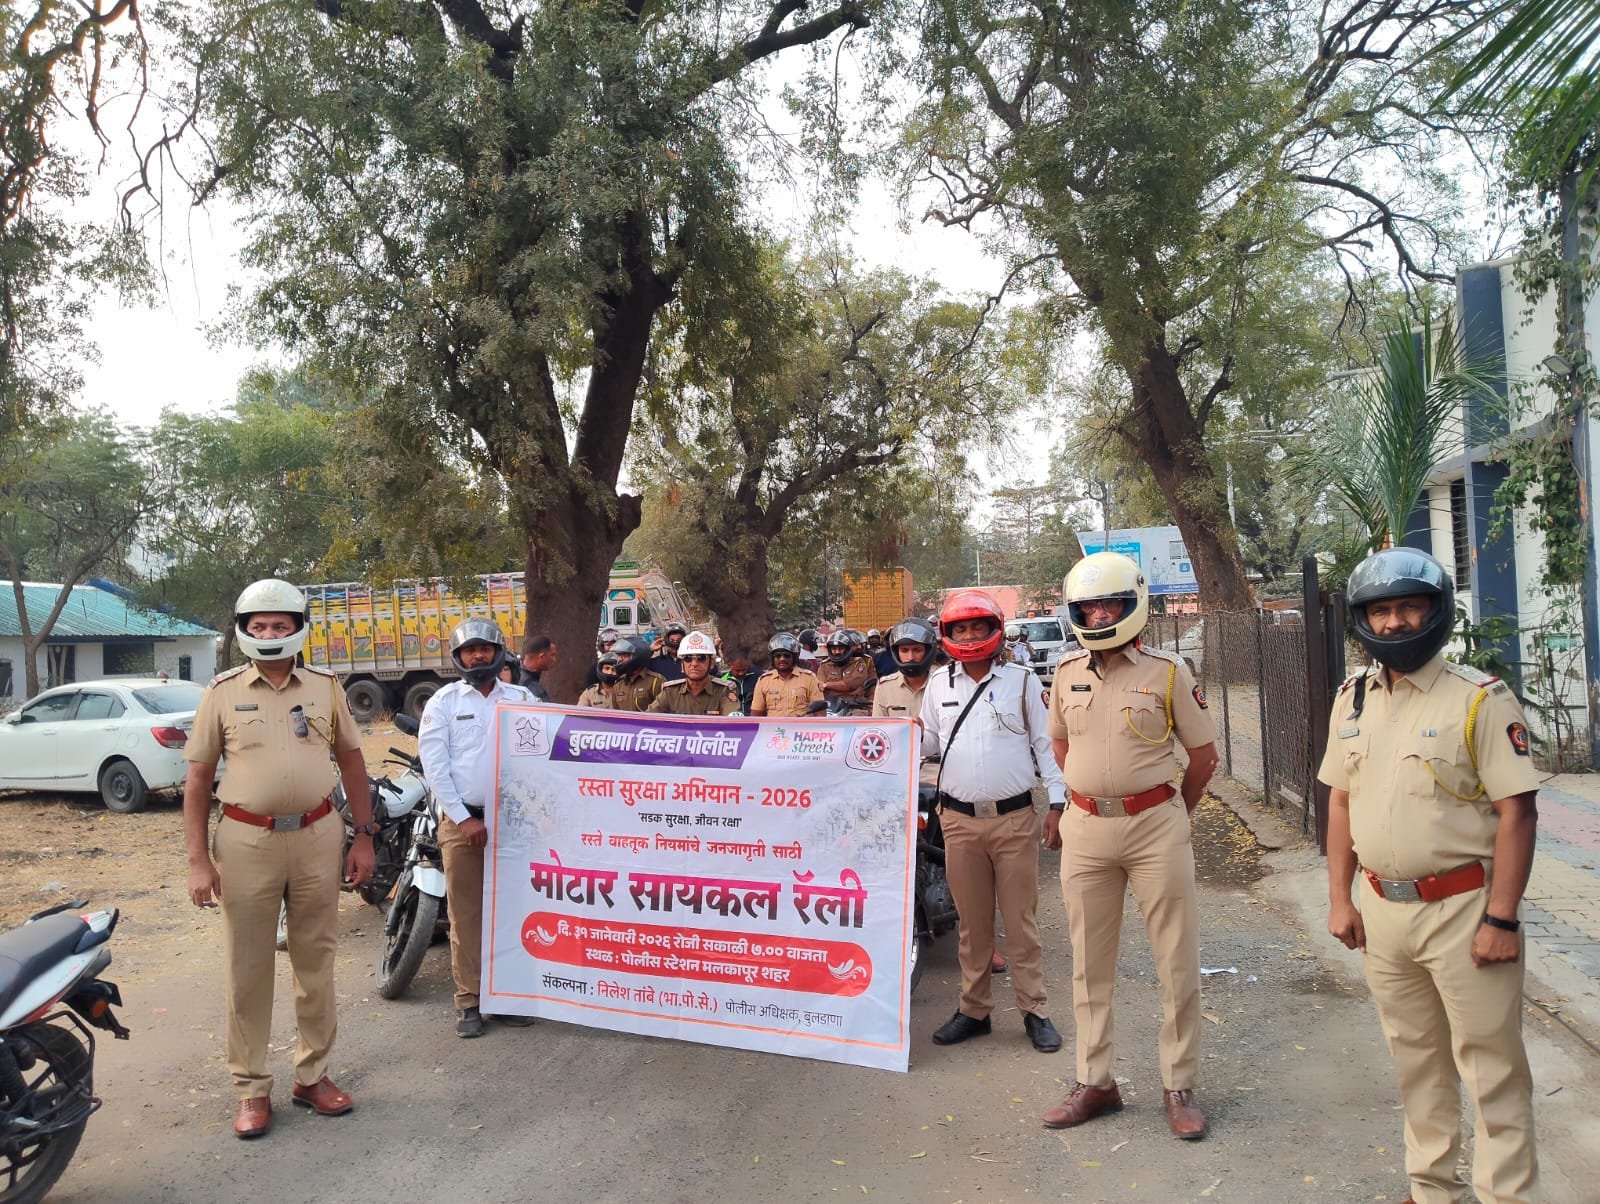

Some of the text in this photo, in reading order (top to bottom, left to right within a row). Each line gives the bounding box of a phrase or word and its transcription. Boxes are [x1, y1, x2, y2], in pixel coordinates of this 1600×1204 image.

[569, 728, 741, 757] बुलढाणा जिल्हा पोलीस
[792, 741, 834, 754] streets
[793, 731, 836, 742] HAPPY
[578, 777, 615, 798] रस्ता
[619, 780, 667, 807] सुरक्षा
[672, 777, 741, 804] अभियान
[761, 787, 812, 809] 2026
[665, 814, 692, 828] सुरक्षा,
[695, 813, 719, 826] जीवन
[581, 829, 803, 861] रस्ते वाहतूक नियमांचे जनजागृती साठी
[530, 849, 869, 929] मोटार सायकल रॅली
[557, 919, 572, 936] दि.
[574, 925, 588, 940] ३१
[590, 926, 637, 945] जानेवारी
[638, 933, 671, 949] २०२६
[673, 933, 700, 950] रोजी
[703, 937, 749, 955] सकाळी
[786, 946, 828, 963] वाजता
[585, 948, 613, 963] स्थळ
[621, 949, 662, 968] पोलीस
[663, 953, 700, 972] स्टेशन
[702, 960, 759, 983] मलकापूर
[761, 966, 791, 983] शहर
[542, 972, 588, 995] संकल्पना
[597, 980, 630, 1000] निलेश
[633, 985, 655, 1004] तांबे
[659, 989, 718, 1014] (भा.पो.से.)
[725, 998, 756, 1017] पोलीस
[759, 1003, 801, 1023] अधिक्षक,
[804, 1009, 843, 1028] बुलडाणा
